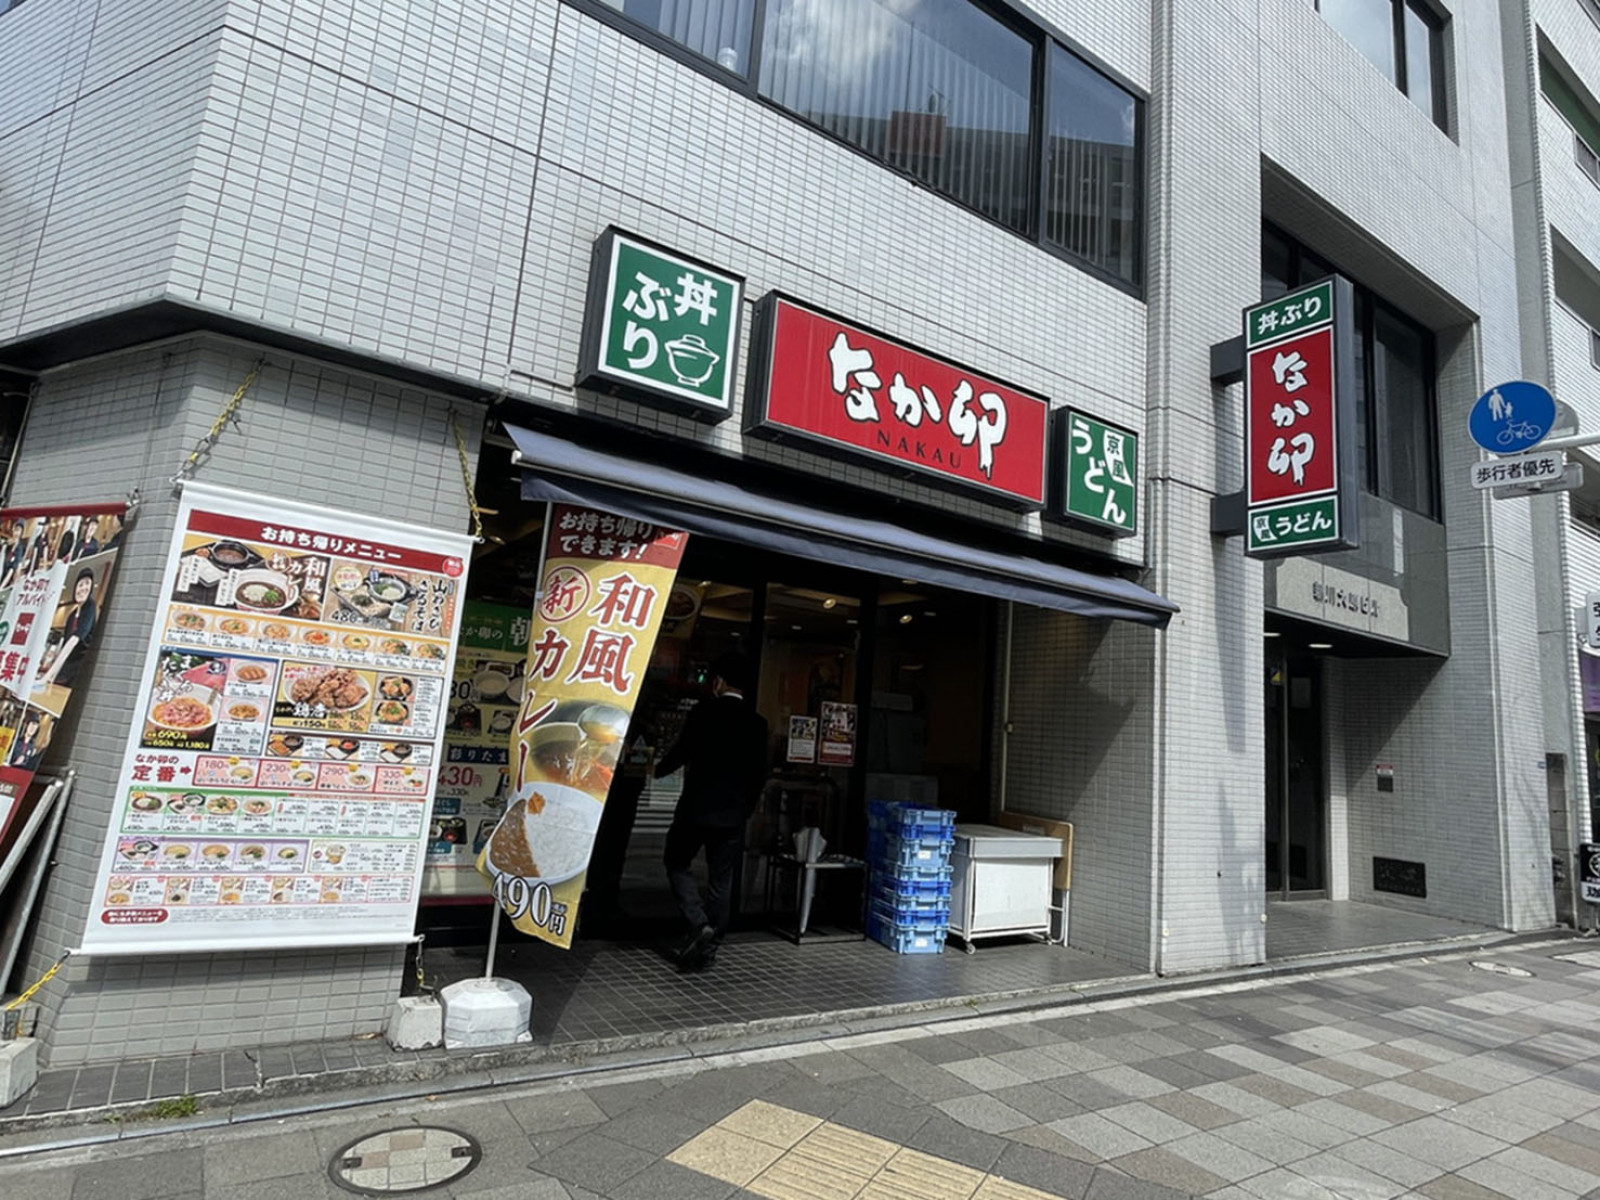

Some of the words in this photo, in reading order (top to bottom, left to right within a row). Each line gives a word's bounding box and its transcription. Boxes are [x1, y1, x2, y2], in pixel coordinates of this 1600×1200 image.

[1257, 296, 1321, 335] 丼ぶり
[828, 331, 1008, 480] なか卯
[1267, 351, 1316, 486] なか卯
[876, 427, 963, 471] NAKAU
[1105, 433, 1127, 482] 京風
[1071, 419, 1127, 525] うどん
[1476, 459, 1556, 483] 歩行者優先
[261, 526, 402, 560] お持ち帰りメニュー
[559, 512, 653, 539] お持ち帰り
[1274, 510, 1332, 537] うどん
[543, 574, 584, 617] 新
[567, 573, 656, 695] 和風
[516, 629, 570, 793] カレー
[131, 765, 176, 782] 定番
[135, 754, 180, 765] なか卯の
